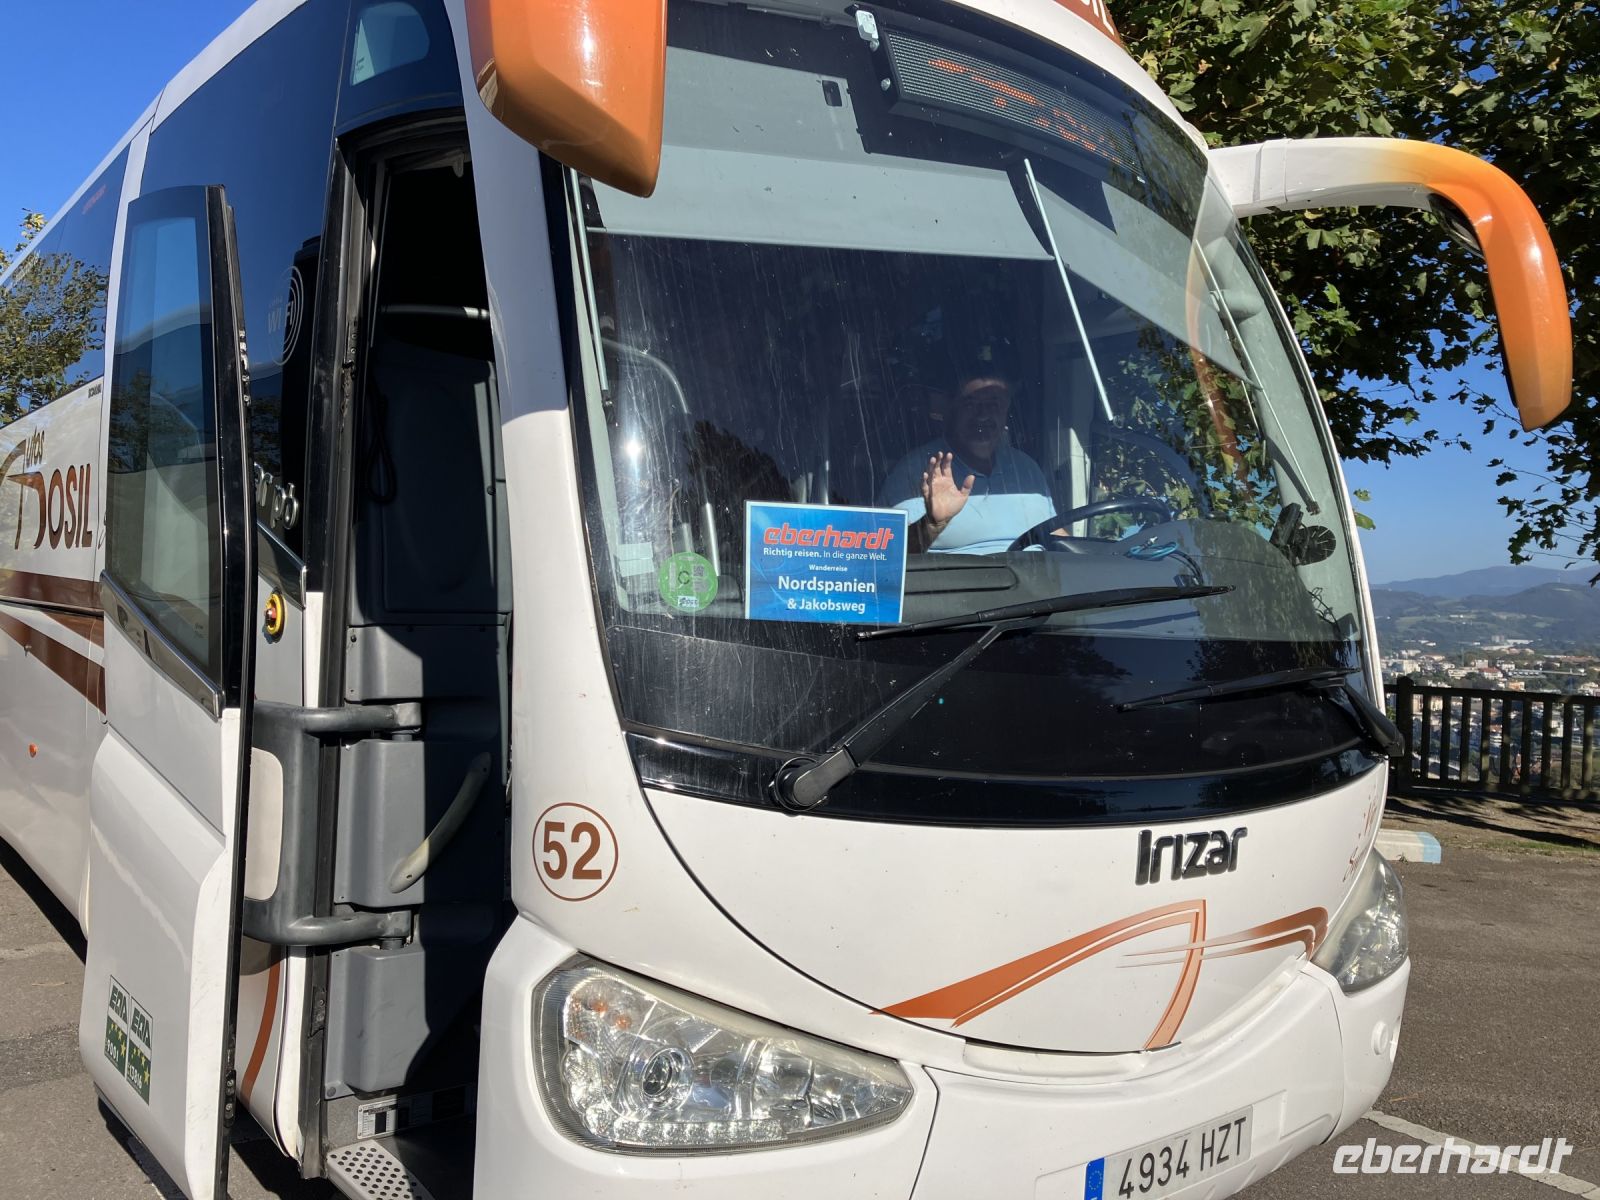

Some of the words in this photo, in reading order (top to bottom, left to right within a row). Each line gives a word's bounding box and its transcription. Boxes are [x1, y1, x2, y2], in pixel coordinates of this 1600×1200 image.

[763, 522, 895, 550] eberhardt
[763, 547, 793, 558] Richtig
[794, 549, 822, 558] reisen.
[823, 550, 831, 558] In
[832, 550, 844, 559] die
[845, 552, 868, 561] ganze
[869, 551, 887, 561] Welt.
[808, 563, 848, 572] Wanderreise
[778, 575, 875, 594] Nordspanien
[787, 599, 797, 609] &
[799, 598, 866, 614] Jakobsweg
[543, 821, 602, 880] 52
[1135, 826, 1247, 886] Irizar
[1118, 1139, 1190, 1199] 4934
[1200, 1116, 1247, 1171] HZT
